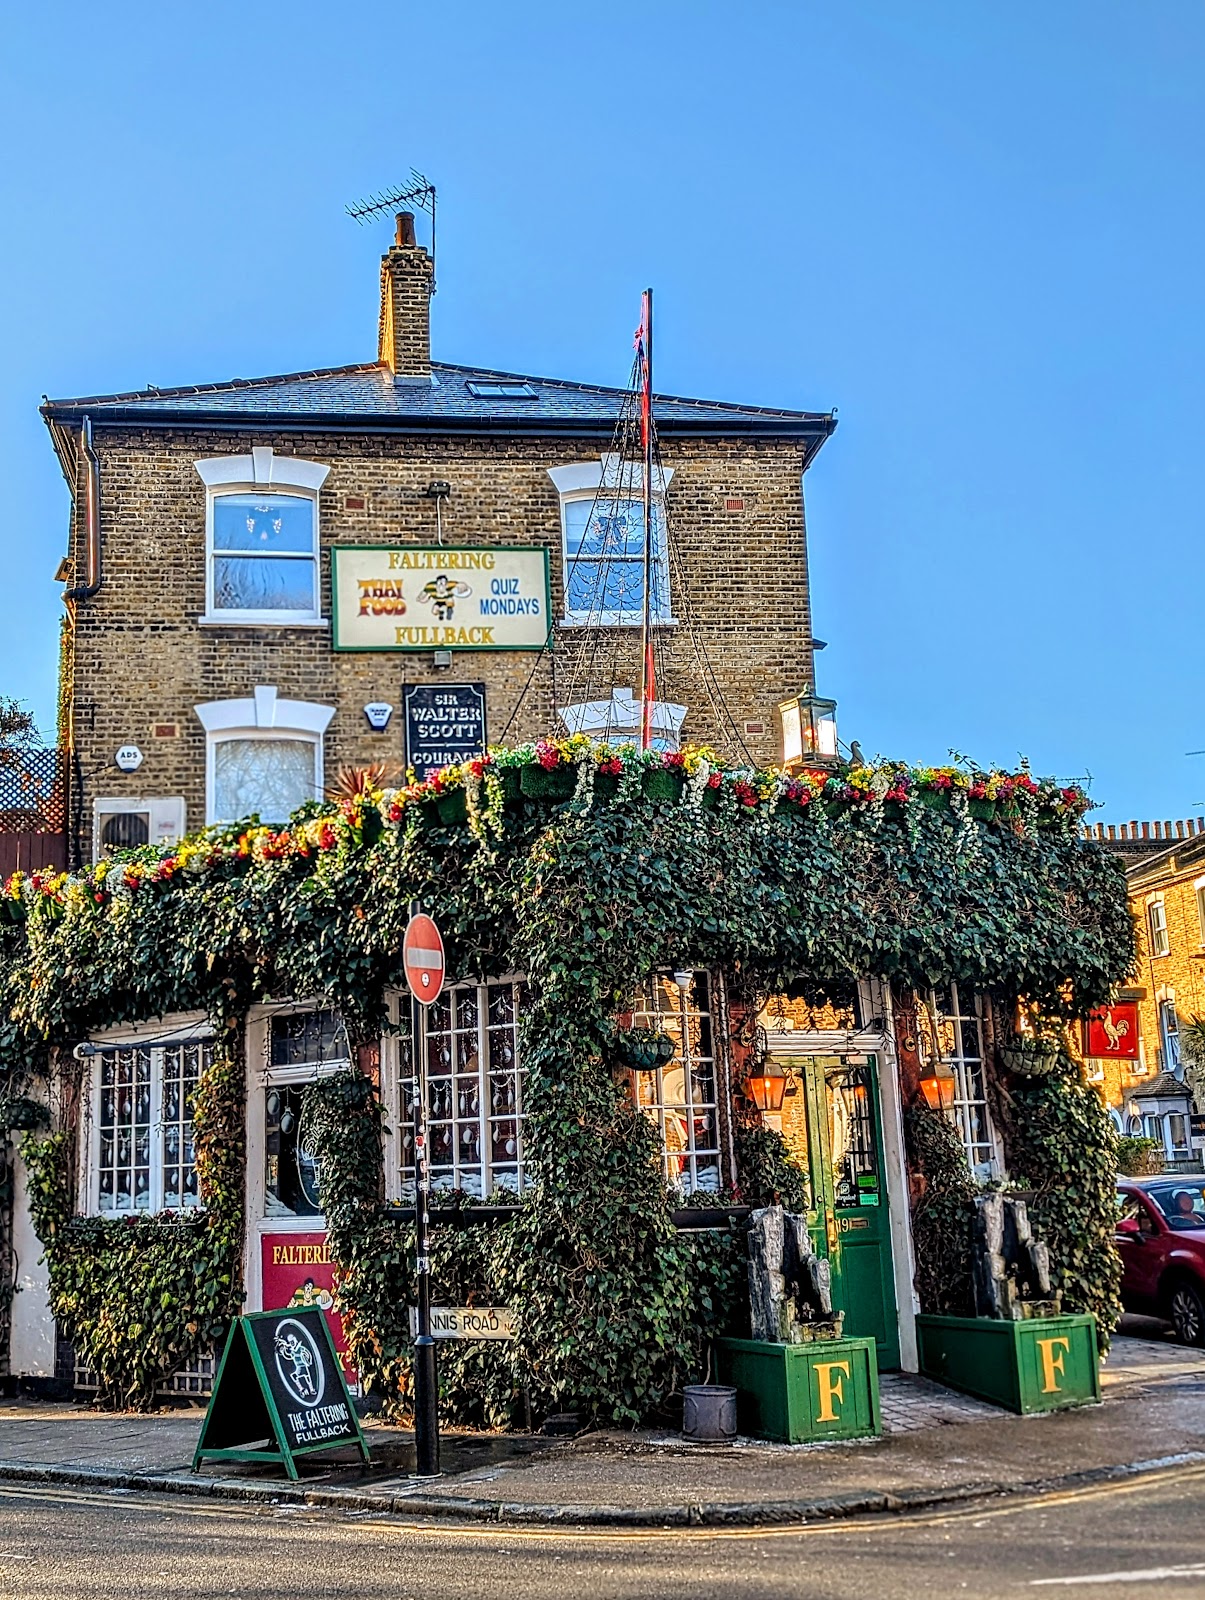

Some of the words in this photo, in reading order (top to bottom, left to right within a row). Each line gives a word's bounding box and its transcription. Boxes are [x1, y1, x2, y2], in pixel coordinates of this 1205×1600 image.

[388, 552, 495, 570] FALTERING
[357, 578, 405, 599] THAI
[490, 578, 519, 596] QUIZ
[357, 598, 407, 617] FOOD
[480, 598, 540, 615] MONDAYS
[395, 626, 495, 644] FULLBACK
[434, 694, 459, 706] SIR
[412, 707, 482, 721] WALTER
[417, 724, 478, 738] SCOTT
[120, 751, 138, 759] ADS
[273, 1245, 331, 1264] FALTERI
[430, 1315, 458, 1331] NNIS
[463, 1315, 499, 1331] ROAD
[1036, 1337, 1070, 1393] F
[812, 1361, 850, 1423] F
[288, 1412, 307, 1432] THE
[305, 1402, 349, 1430] FALTERING
[295, 1423, 352, 1444] FULLBACK
